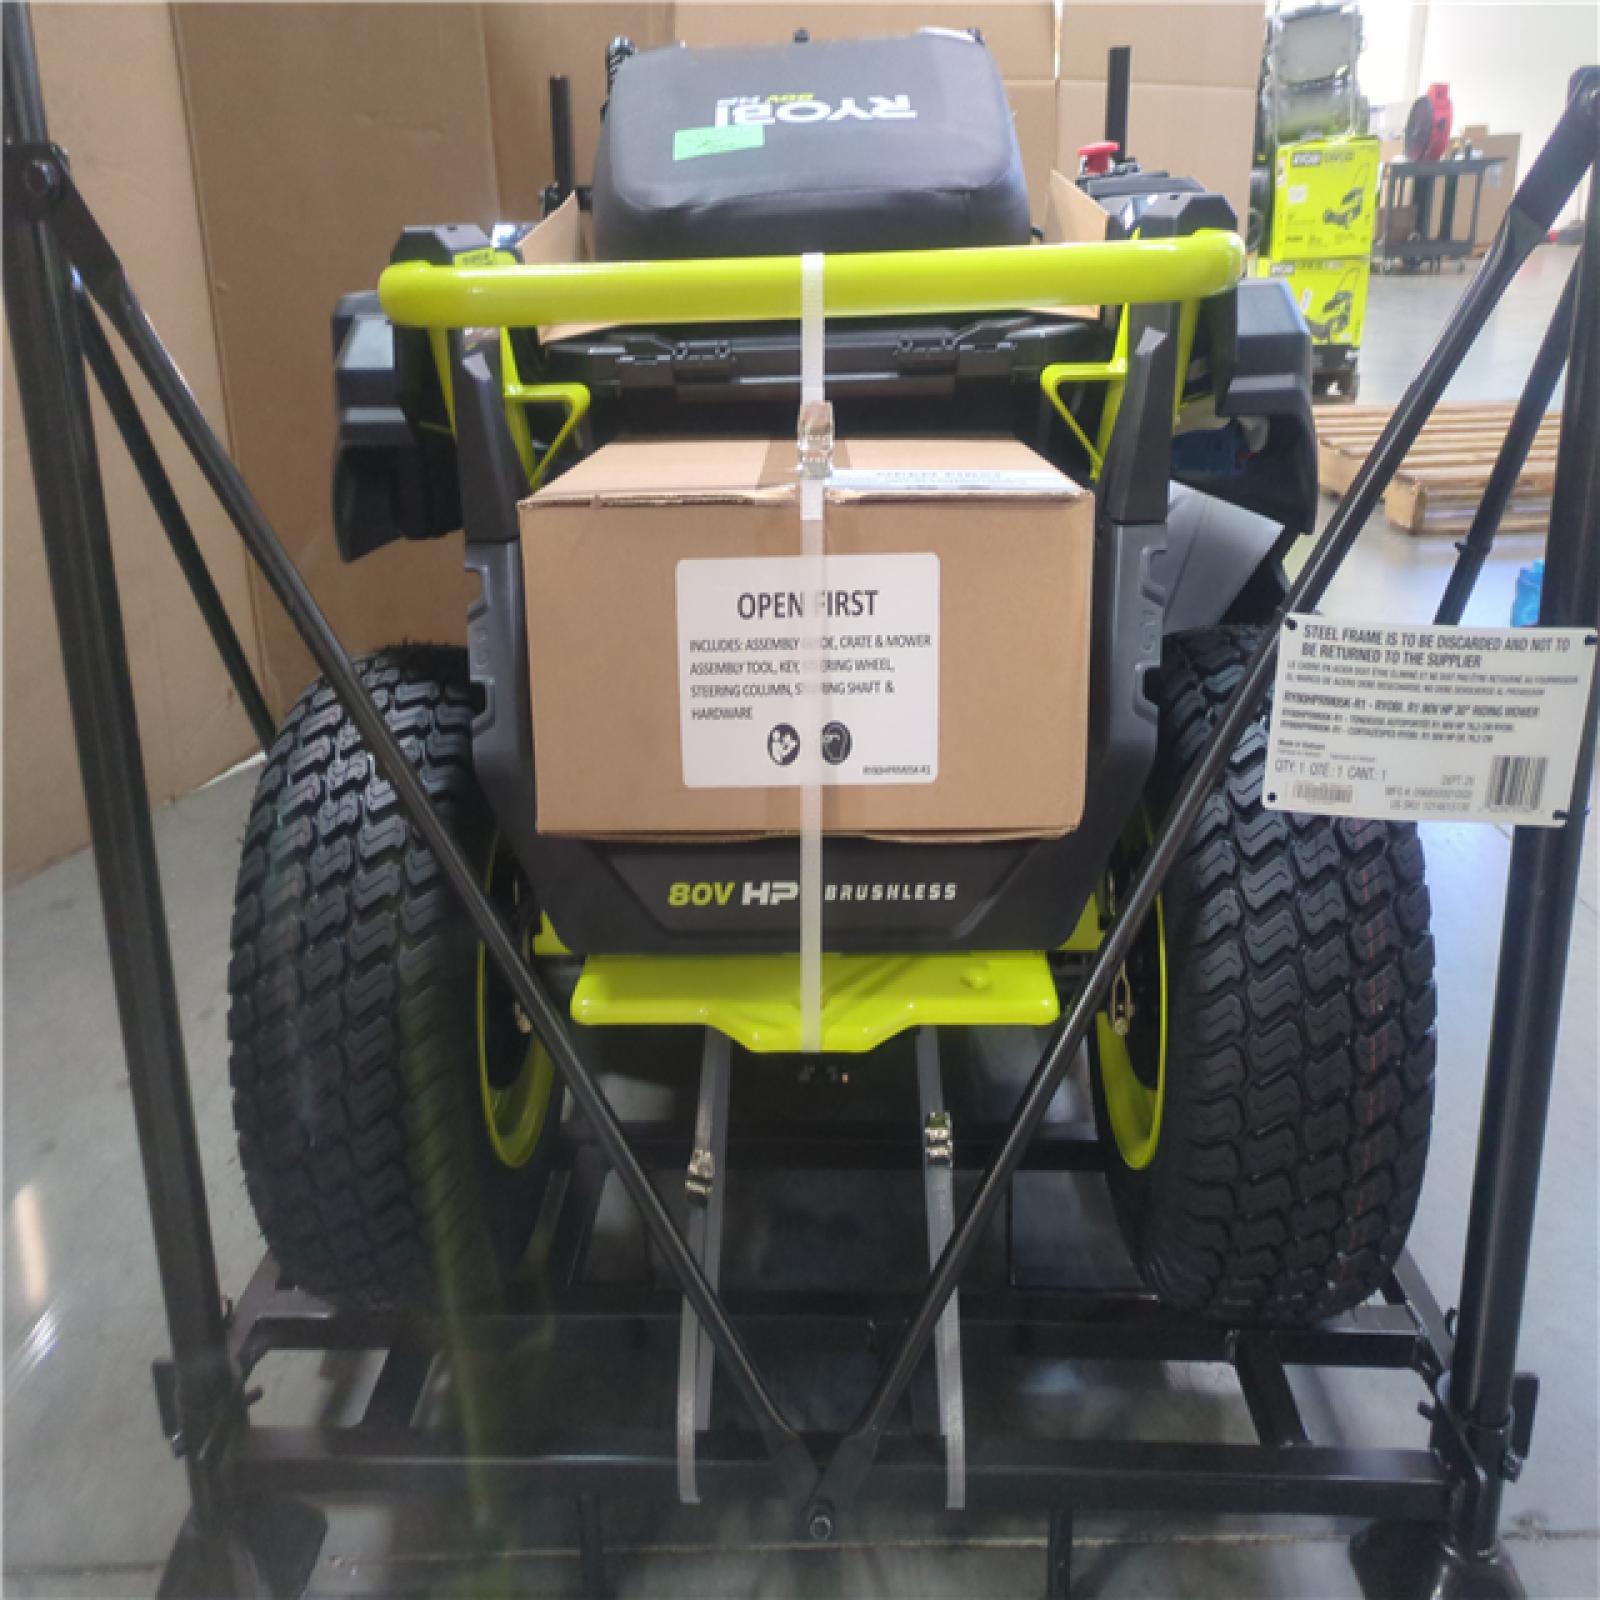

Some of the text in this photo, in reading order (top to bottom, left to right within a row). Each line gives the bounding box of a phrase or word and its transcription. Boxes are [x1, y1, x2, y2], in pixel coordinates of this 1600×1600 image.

[737, 591, 804, 620] OPEN
[690, 638, 741, 653] INCLUDES:
[744, 636, 799, 651] ASSEMBLY
[840, 635, 873, 648] CRATE
[875, 635, 883, 648] &
[885, 634, 931, 648] MOWER
[1304, 624, 1570, 653] STEEL FRAME IS TO BE DISCARDED AND NOT TO
[1302, 642, 1482, 668] BE RETURNED TO THE SUPPLIER
[690, 661, 744, 676] ASSEMBLY
[746, 660, 777, 675] TOOL,
[855, 657, 895, 672] WHEEL,
[690, 684, 741, 699] STEERING
[847, 680, 881, 694] SHAFT
[884, 680, 895, 694] &
[691, 705, 753, 720] HARDWARE
[668, 881, 957, 906] 80V HP BRUSHLESS
